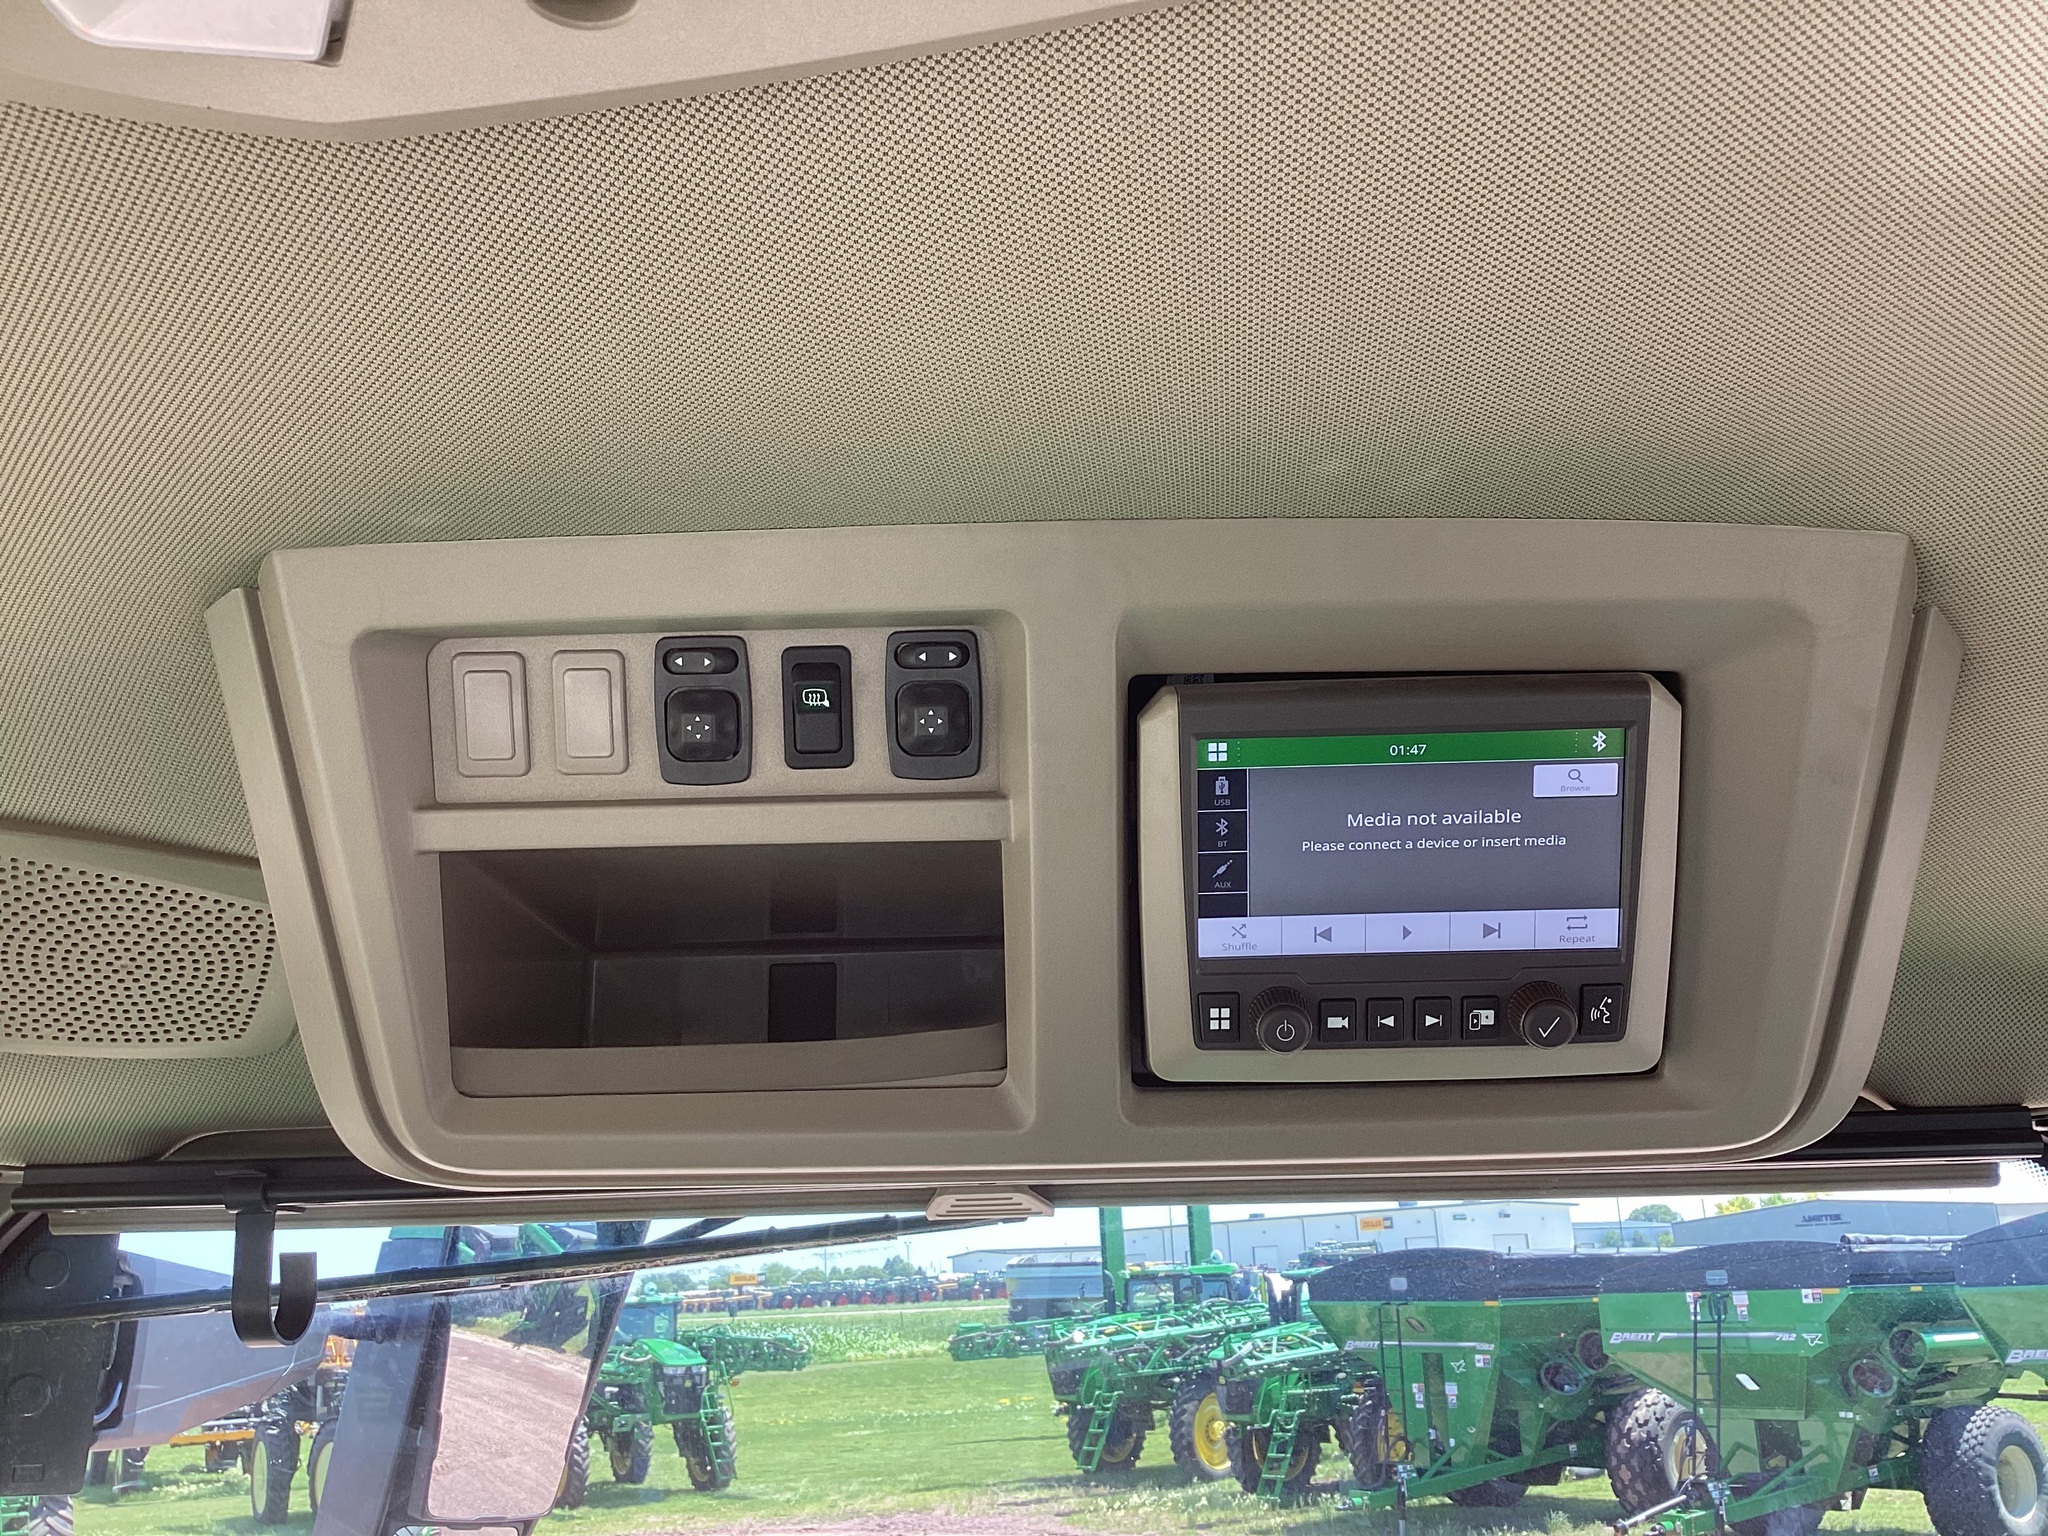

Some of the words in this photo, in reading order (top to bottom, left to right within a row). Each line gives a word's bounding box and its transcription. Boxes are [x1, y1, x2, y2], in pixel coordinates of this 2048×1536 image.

[1389, 744, 1427, 756] 01:47
[1560, 784, 1591, 792] Browse
[1346, 812, 1402, 828] Media
[1407, 812, 1437, 826] not
[1442, 808, 1522, 825] available
[1217, 840, 1228, 848] BT
[1302, 840, 1345, 852] Please
[1348, 839, 1402, 850] connect
[1405, 840, 1413, 849] a
[1416, 837, 1460, 849] device
[1463, 838, 1478, 848] or
[1481, 836, 1521, 847] insert
[1524, 834, 1567, 846] media
[1214, 881, 1232, 889] AUX
[1559, 934, 1596, 945] Repeat
[1221, 941, 1258, 951] Shuffle
[1609, 1332, 1656, 1344] BRENT
[1343, 1341, 1379, 1351] BRENT
[2005, 1349, 2048, 1364] BRE
